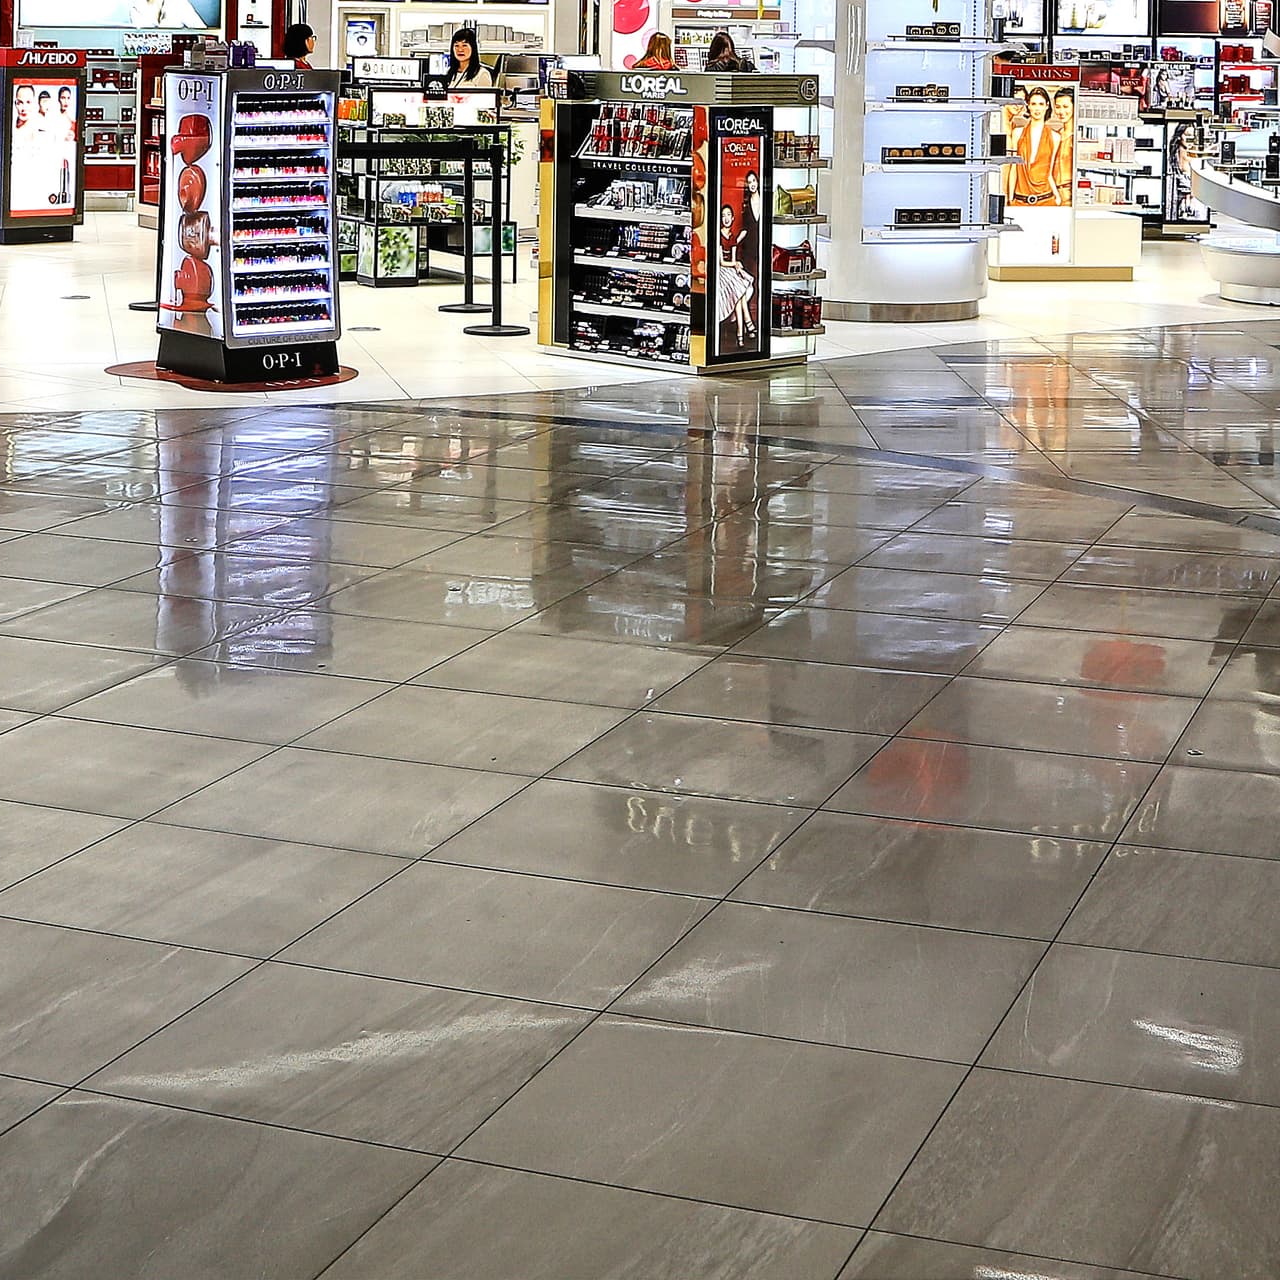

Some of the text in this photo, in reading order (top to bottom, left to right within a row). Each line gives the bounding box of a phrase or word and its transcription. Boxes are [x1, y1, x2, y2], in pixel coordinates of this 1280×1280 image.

[16, 51, 77, 66] SHISEIDO
[370, 64, 412, 75] ORIGINS
[1008, 68, 1072, 79] CLARINS
[620, 74, 688, 95] L'ORÉAL
[642, 91, 666, 100] PARIS
[717, 116, 764, 131] L'ORÉAL
[592, 160, 679, 175] TRAVEL COLLECTION
[247, 335, 281, 346] CULTURE
[283, 333, 295, 343] OF
